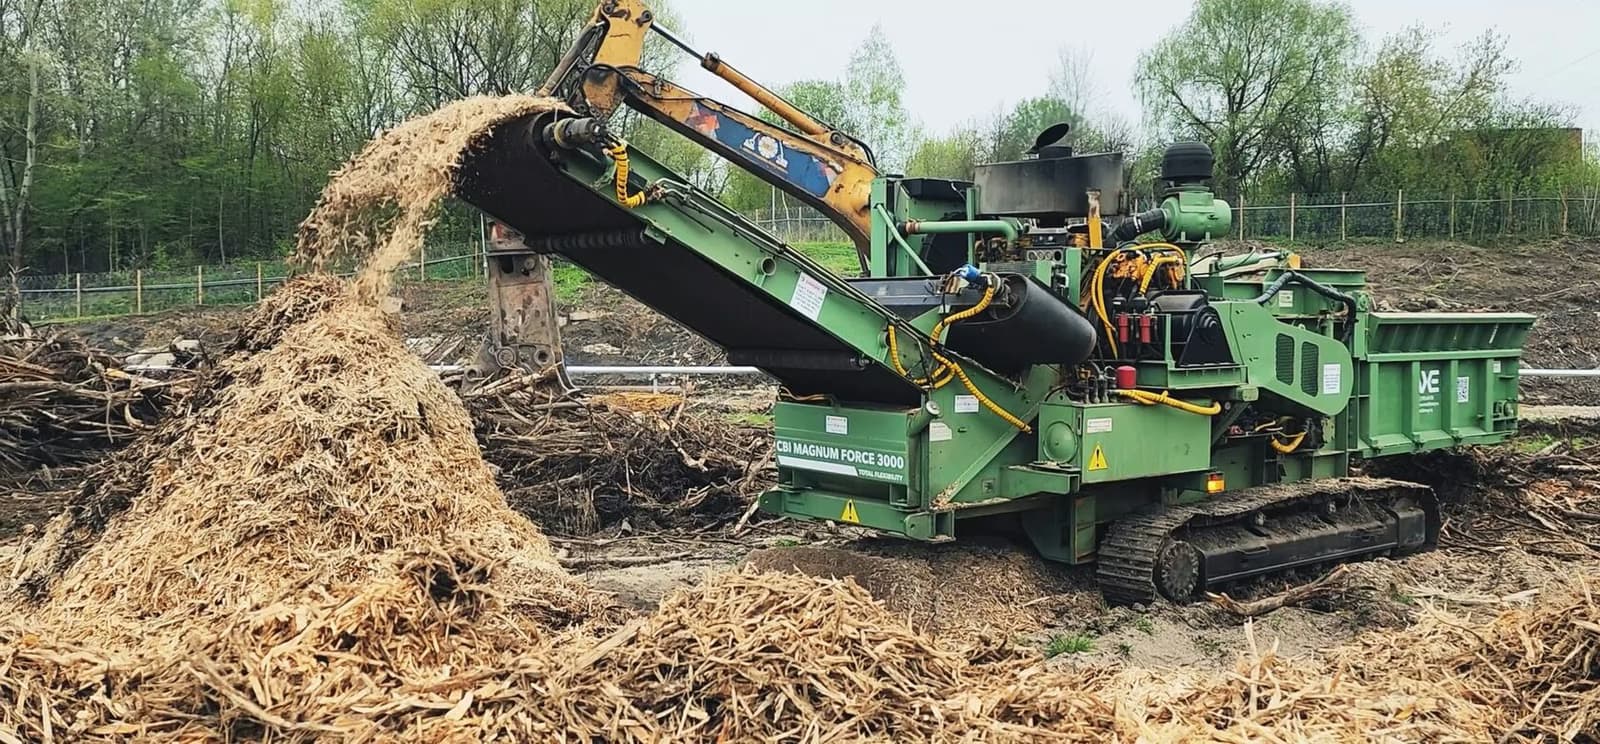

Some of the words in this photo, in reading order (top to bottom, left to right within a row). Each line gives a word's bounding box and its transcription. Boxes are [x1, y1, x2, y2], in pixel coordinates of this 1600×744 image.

[777, 440, 791, 453] CBI
[793, 443, 839, 460] MAGNUM
[841, 449, 875, 465] FORCE
[877, 453, 904, 469] 3000
[858, 469, 874, 477] TOTAL
[874, 471, 903, 481] FLEXIBILITY
